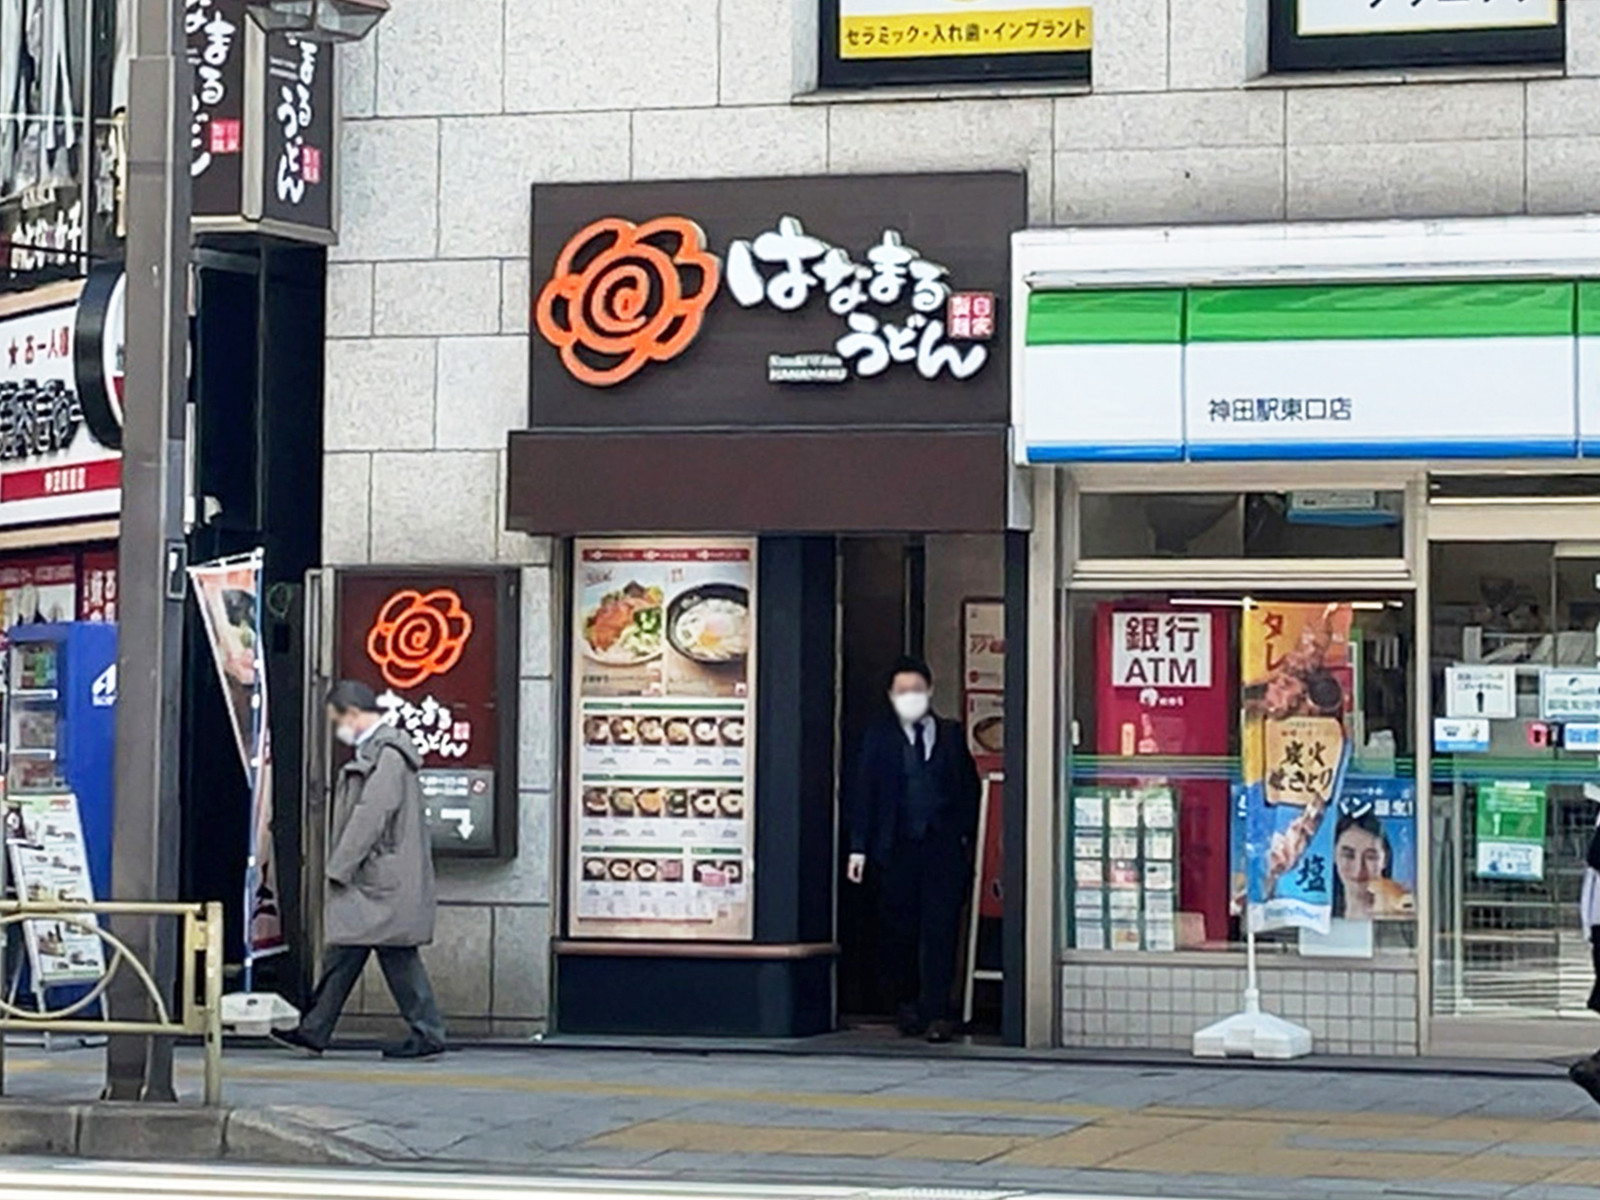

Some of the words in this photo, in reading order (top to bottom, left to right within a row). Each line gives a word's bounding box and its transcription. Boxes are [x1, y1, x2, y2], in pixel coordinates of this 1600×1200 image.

[726, 216, 952, 313] はなまる
[836, 311, 987, 379] うどん
[1208, 397, 1353, 423] 神田駅東口店
[1125, 616, 1200, 653] 銀行
[1263, 611, 1287, 672] タレ
[1125, 657, 1198, 684] ATM
[1295, 853, 1327, 893] 塩
